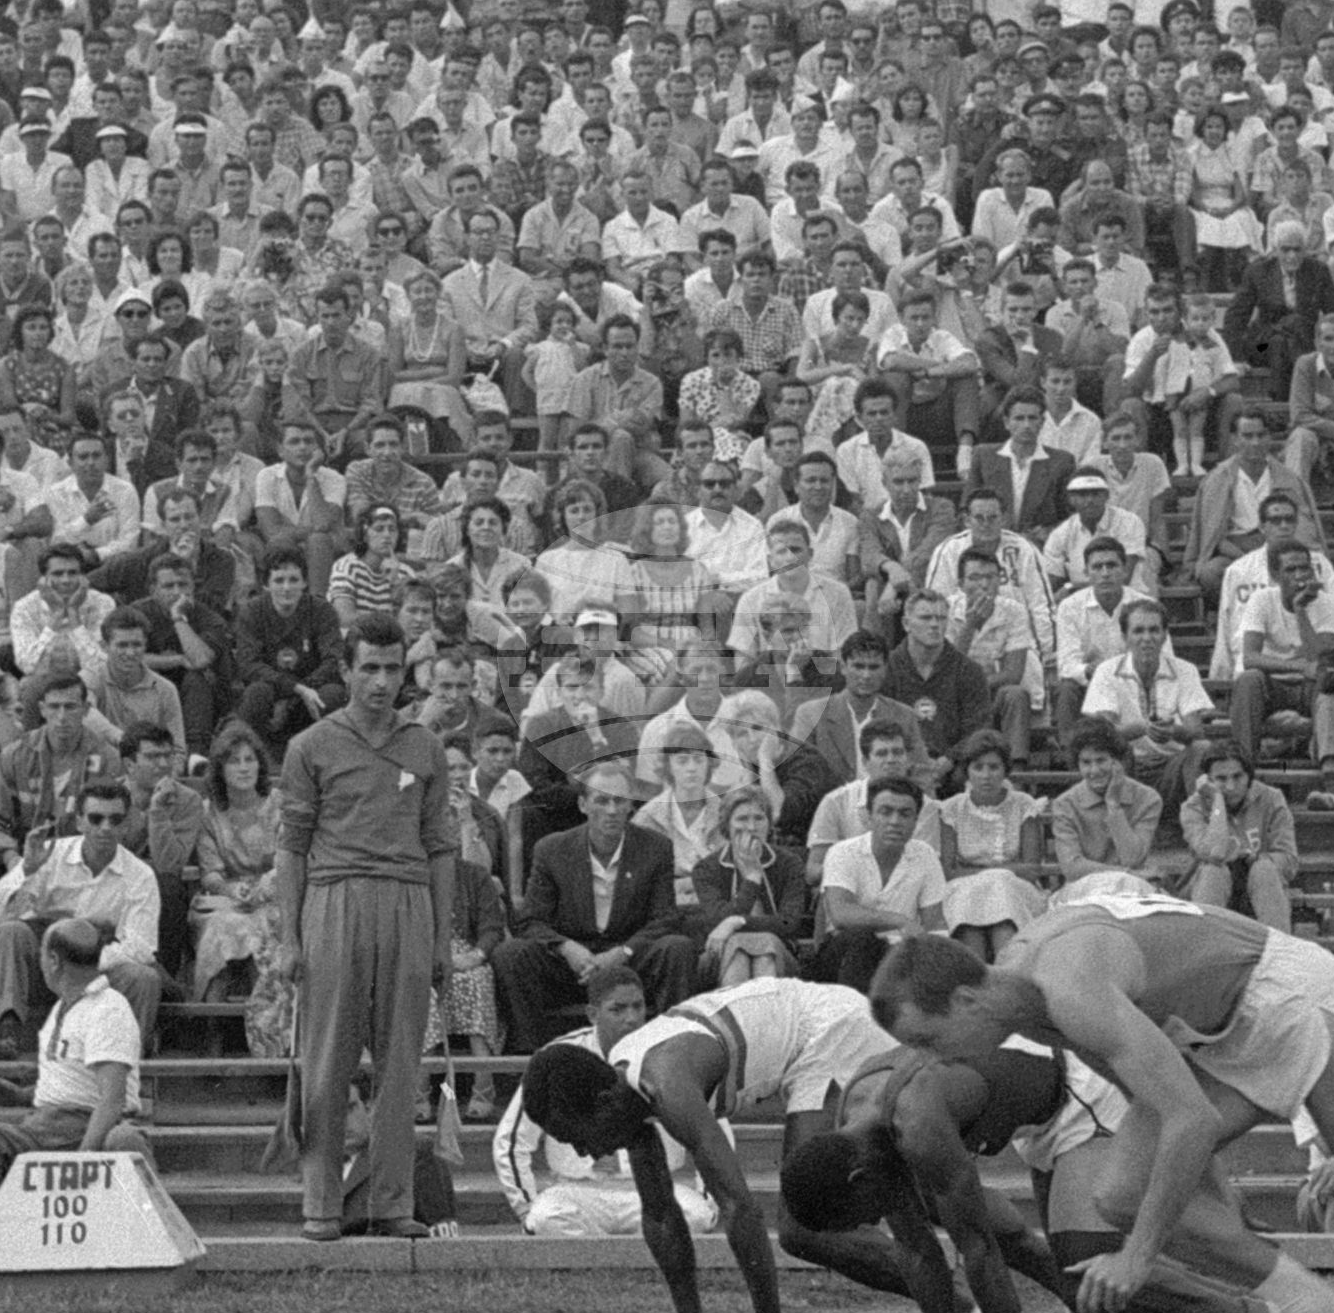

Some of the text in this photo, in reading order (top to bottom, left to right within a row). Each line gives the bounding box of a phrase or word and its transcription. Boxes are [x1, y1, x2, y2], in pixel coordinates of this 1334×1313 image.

[22, 1160, 115, 1192] СТАРТ
[42, 1194, 88, 1219] 100
[40, 1221, 87, 1246] 110
